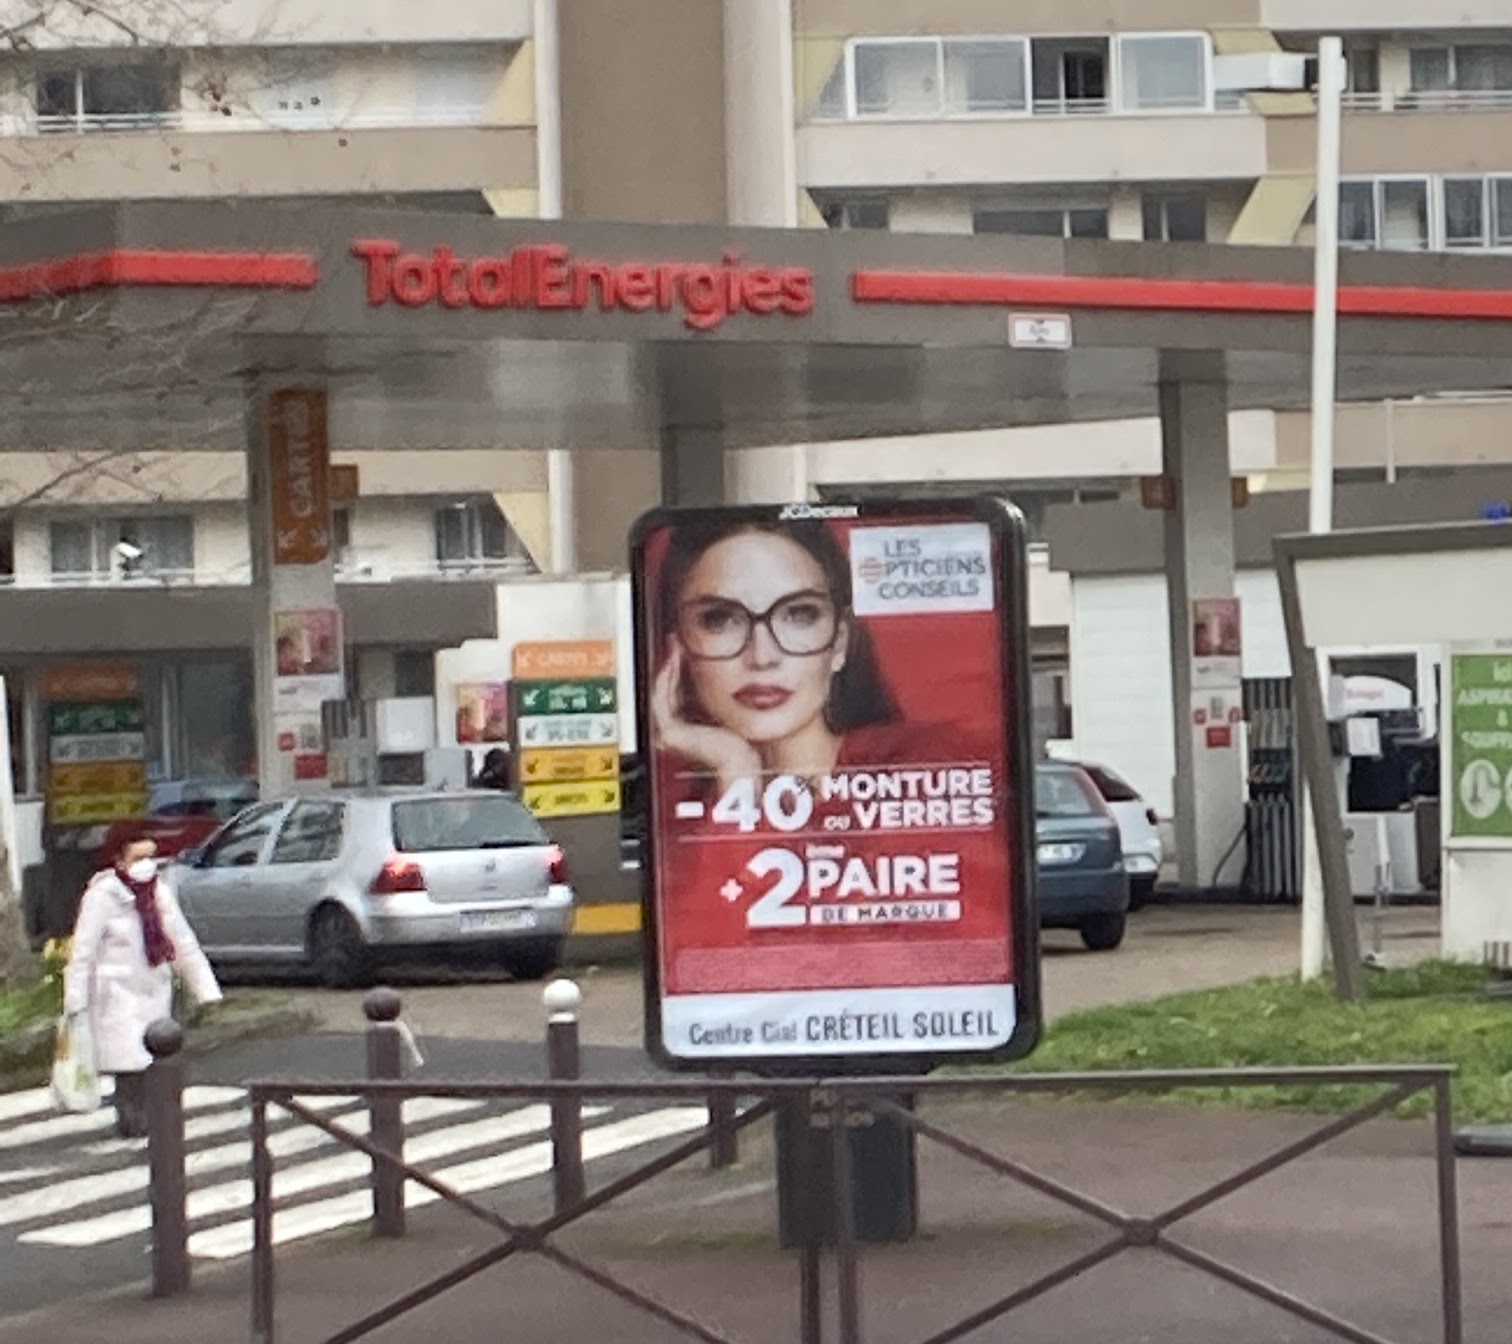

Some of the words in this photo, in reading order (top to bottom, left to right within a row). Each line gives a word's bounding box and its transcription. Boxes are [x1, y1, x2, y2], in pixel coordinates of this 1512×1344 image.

[351, 238, 817, 330] TotalEnergies
[883, 537, 922, 557] LES
[878, 579, 980, 600] CONSEILS
[821, 767, 995, 802] MONTURE
[852, 796, 996, 830] VERRES
[807, 853, 961, 898] PAIRE
[820, 904, 848, 923] DE
[857, 902, 949, 922] MARQUE
[688, 1022, 753, 1046] Centre
[805, 1008, 903, 1042] CRÉTEIL
[912, 1010, 999, 1039] SOLEIL
